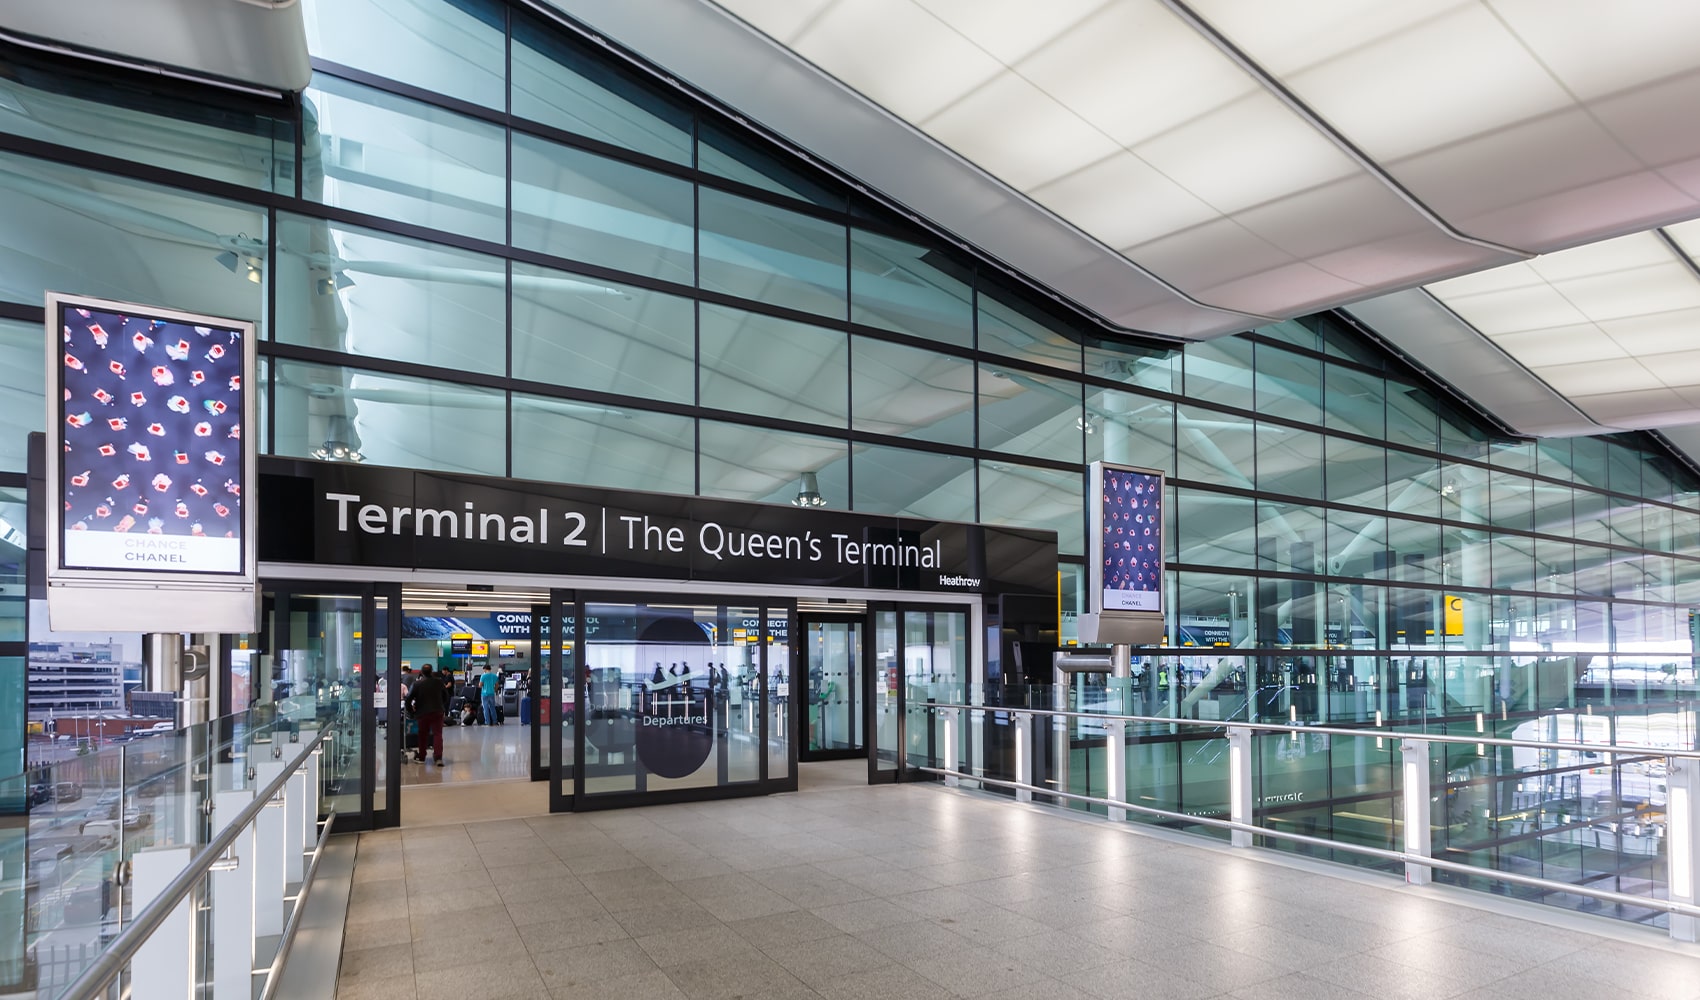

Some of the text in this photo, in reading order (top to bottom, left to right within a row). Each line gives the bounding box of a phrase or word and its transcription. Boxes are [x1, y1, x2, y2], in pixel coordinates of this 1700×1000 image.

[326, 492, 548, 544] Terminal
[563, 512, 587, 546] 2
[620, 515, 684, 551] The
[831, 533, 941, 569] Terminal
[124, 538, 187, 550] CHANCE
[124, 552, 187, 563] CHANEL
[939, 574, 981, 587] Heathrow
[500, 625, 530, 634] WITH
[769, 629, 788, 637] THE
[643, 715, 707, 728] Departures
